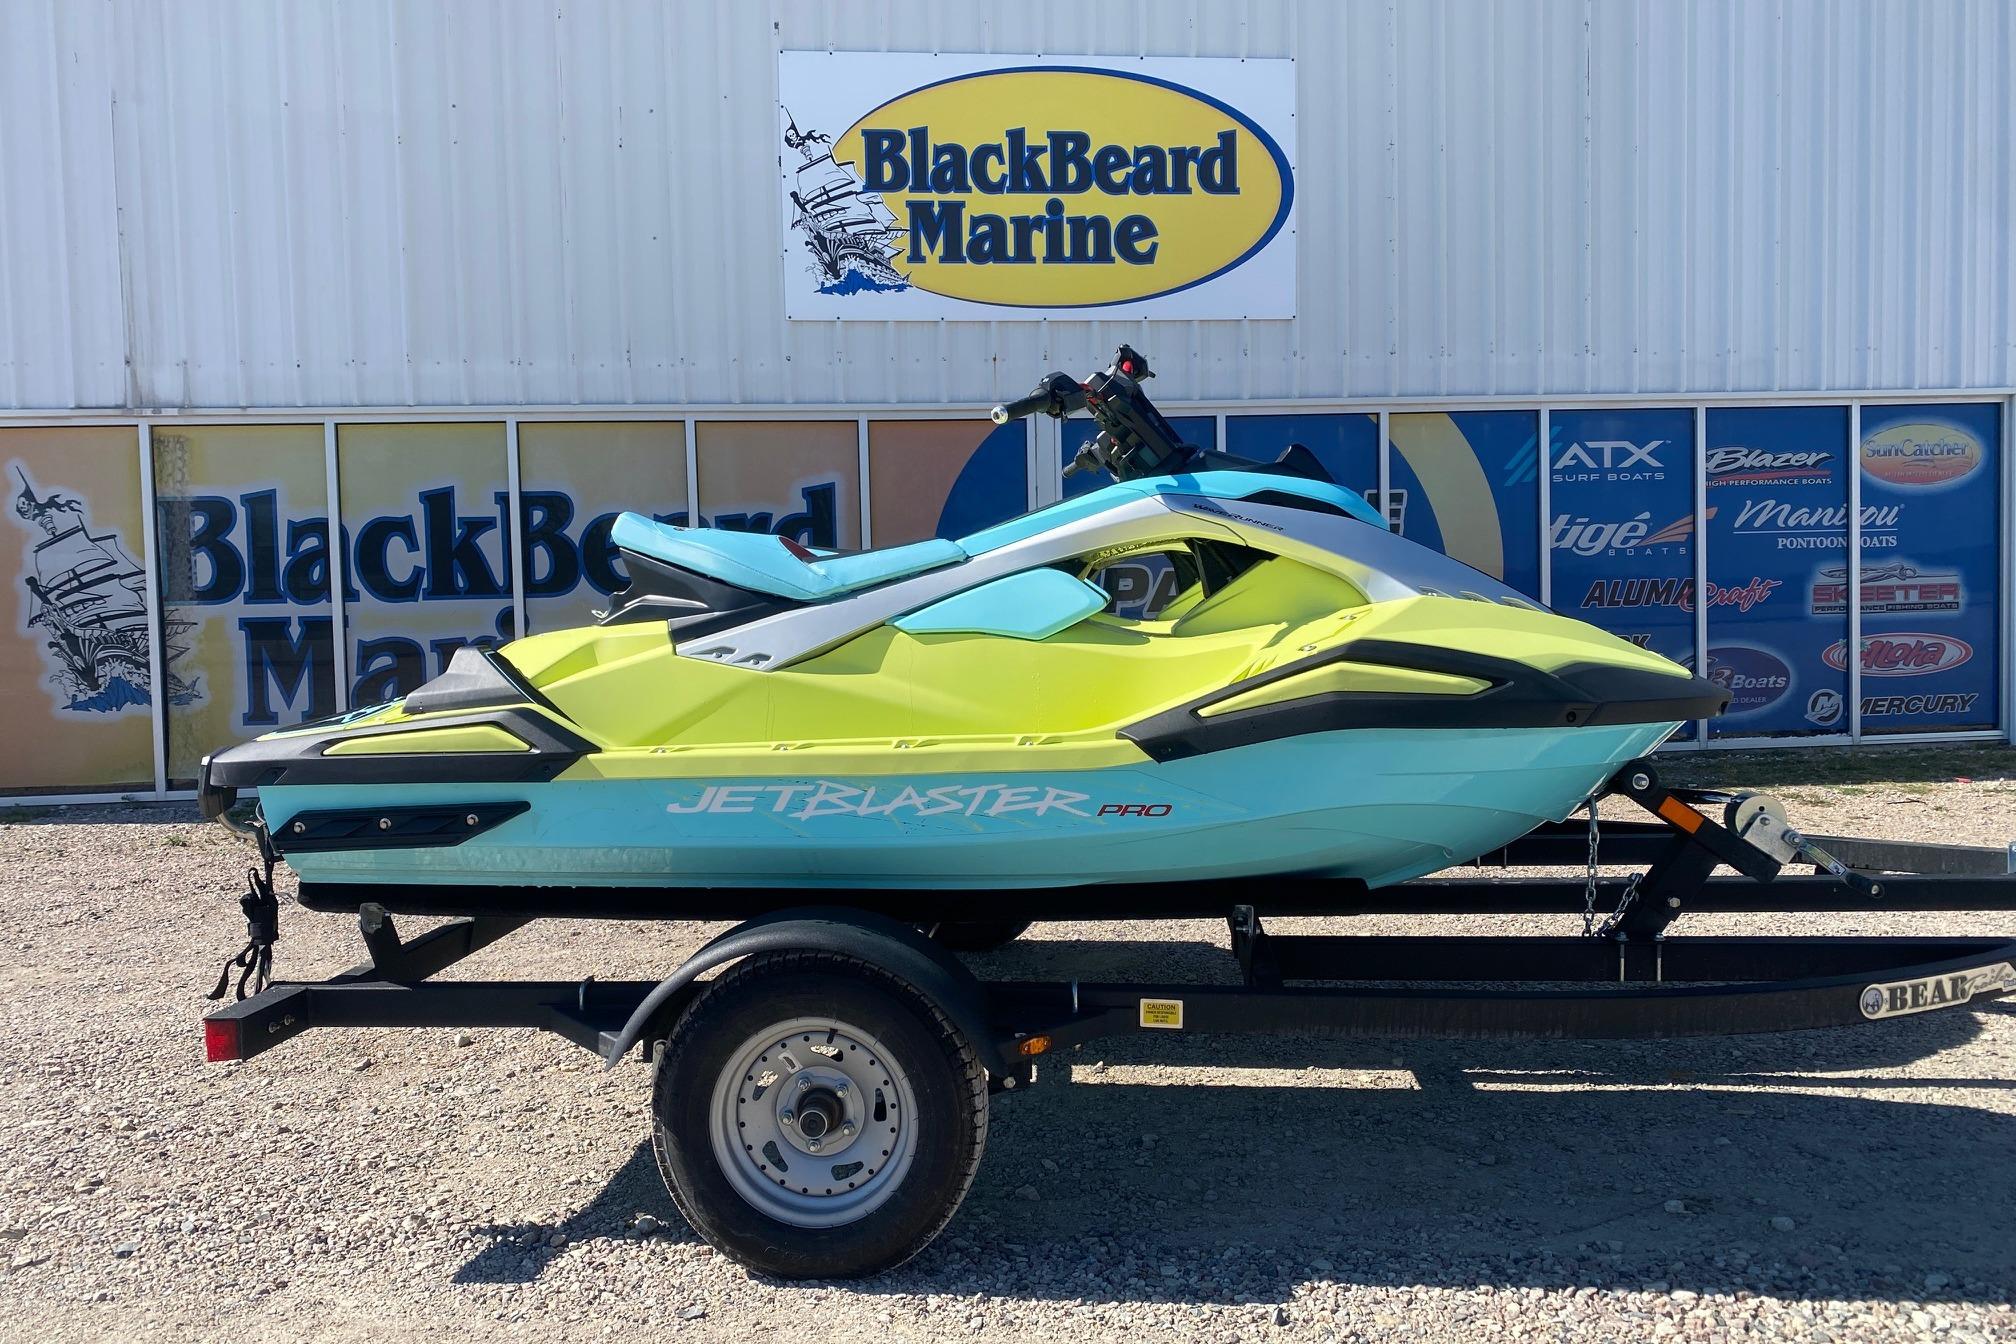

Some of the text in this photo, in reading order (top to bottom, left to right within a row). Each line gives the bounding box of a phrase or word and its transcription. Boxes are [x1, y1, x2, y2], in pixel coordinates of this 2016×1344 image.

[861, 126, 1240, 195] BlackBeard
[906, 198, 1159, 264] Marine
[1552, 441, 1665, 469] ATX
[1866, 438, 1968, 457] SunCatcher
[1706, 446, 1834, 474] Blazer
[1552, 472, 1665, 482] SURF BOATS
[1729, 479, 1800, 487] PERFORMANCE
[1734, 499, 1899, 529] Maniou
[1608, 547, 1687, 556] BOATS
[1777, 535, 1898, 549] PONTOON OATS
[1731, 675, 1787, 688] Boats
[1096, 803, 1173, 818] PRO
[1886, 974, 1969, 1012] BEAR
